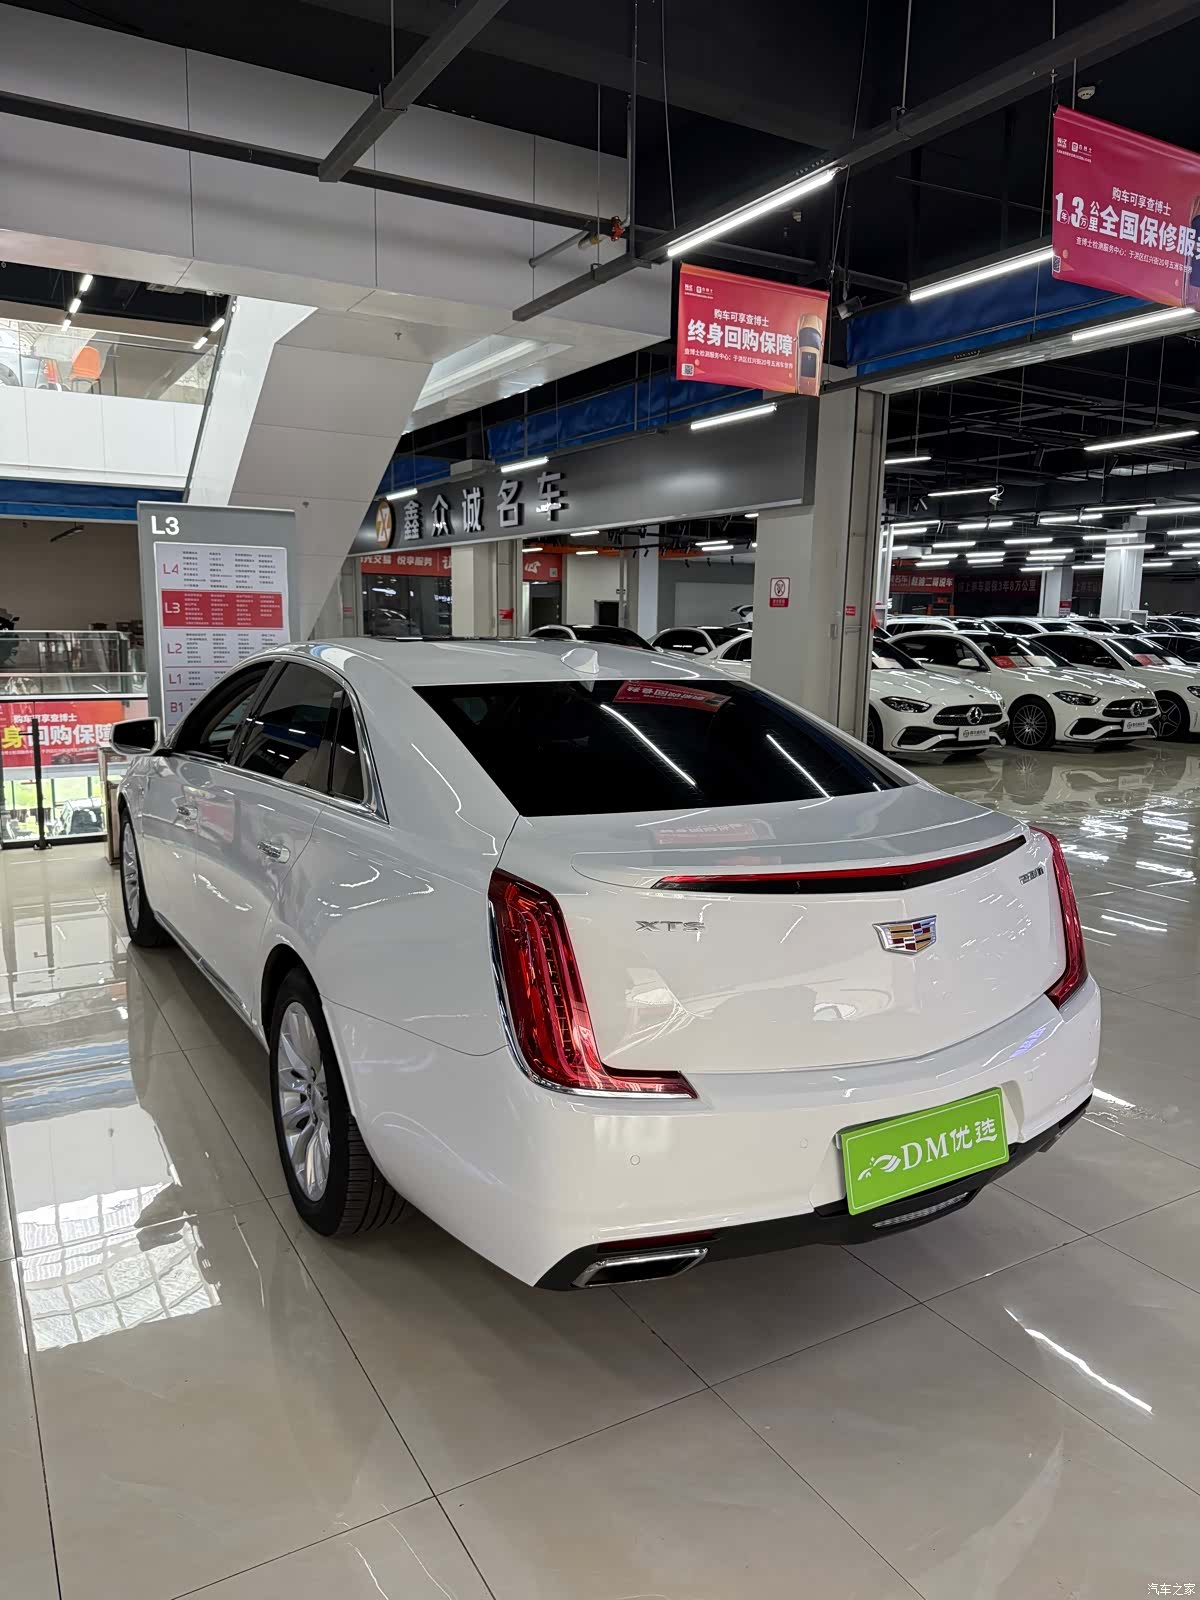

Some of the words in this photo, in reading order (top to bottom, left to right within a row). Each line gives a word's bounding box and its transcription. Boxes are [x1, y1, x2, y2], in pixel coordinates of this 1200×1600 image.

[1112, 187, 1172, 217] 购车可享查博士
[714, 309, 769, 328] 购车可享查博士
[687, 319, 793, 357] 终身回购保障
[403, 471, 562, 540] 鑫众诚名车
[151, 515, 180, 536] L3
[163, 563, 179, 575] L4
[165, 601, 181, 614] L3
[167, 643, 182, 654] L2
[169, 673, 182, 685] L1
[170, 702, 183, 713] B1
[635, 921, 705, 932] XTS
[900, 1117, 998, 1171] DM优选
